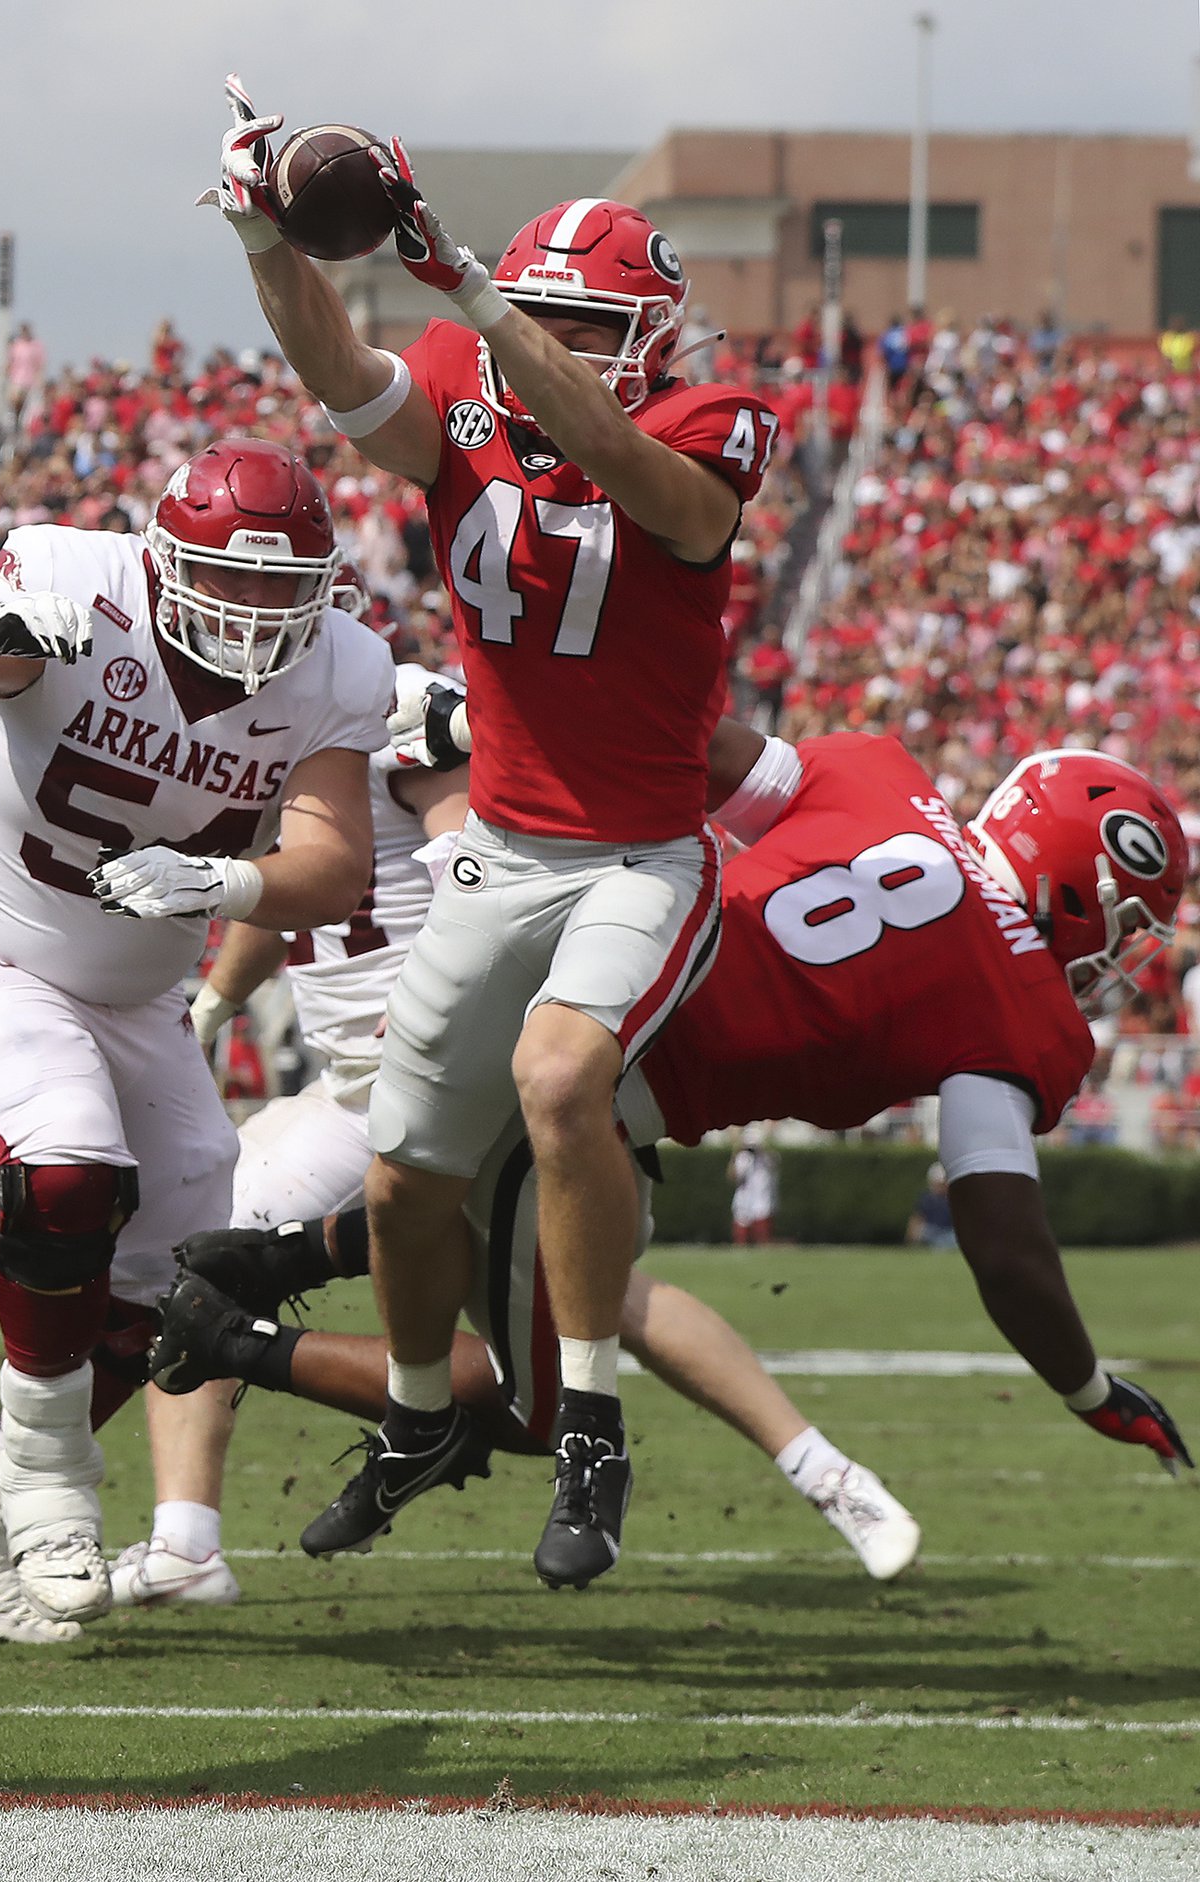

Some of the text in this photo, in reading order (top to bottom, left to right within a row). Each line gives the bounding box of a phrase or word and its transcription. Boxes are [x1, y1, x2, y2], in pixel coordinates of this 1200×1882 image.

[528, 269, 574, 281] DAWGS
[448, 401, 492, 447] SEC
[722, 407, 779, 475] 47
[245, 535, 278, 546] HOGS
[450, 477, 615, 657] 47
[105, 658, 146, 699] SEC
[62, 700, 288, 800] ARKANSAS
[992, 785, 1024, 820] 8
[763, 832, 965, 966] 8
